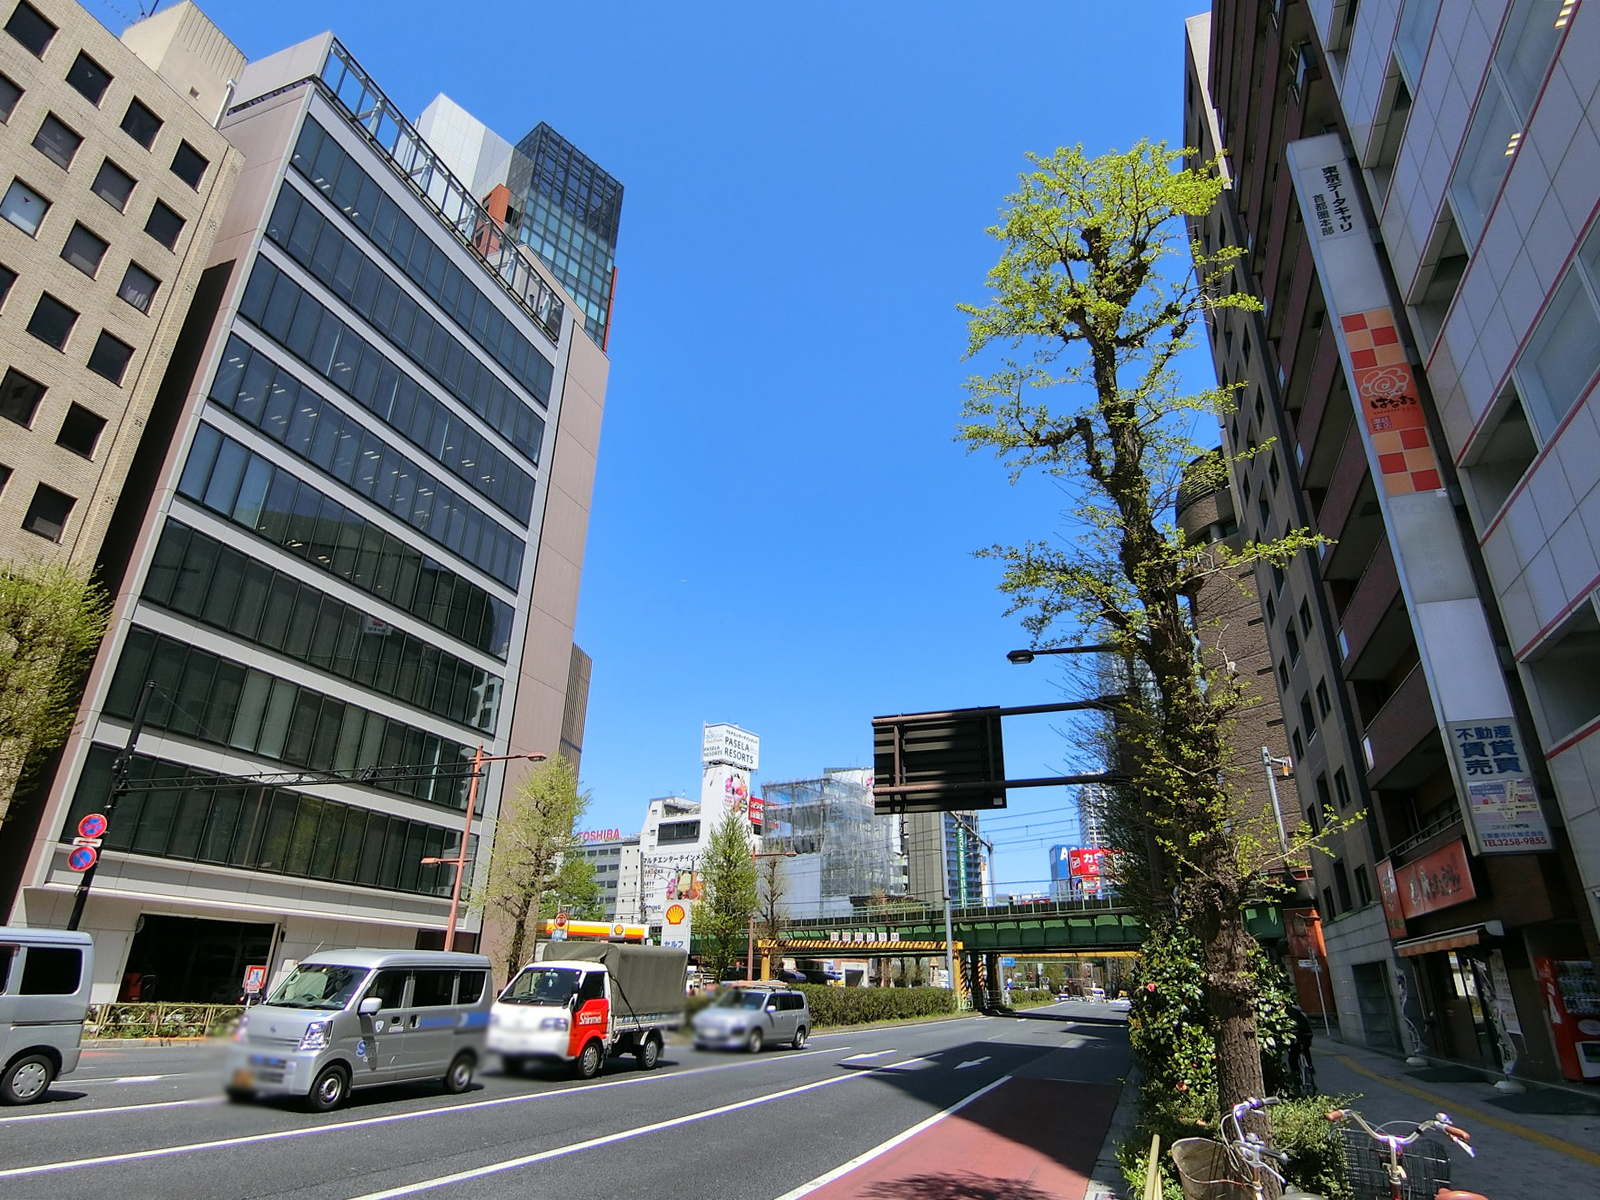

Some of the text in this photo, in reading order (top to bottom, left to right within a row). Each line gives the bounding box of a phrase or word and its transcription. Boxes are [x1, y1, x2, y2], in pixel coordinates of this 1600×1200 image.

[1321, 165, 1353, 232] 東京データキャリ
[1370, 394, 1416, 409] はなまる
[1455, 725, 1513, 741] 不動産
[724, 736, 750, 752] PASELA
[724, 747, 754, 764] RESORTS
[1465, 757, 1523, 775] 売買
[577, 828, 620, 841] TOSHIBA
[1483, 837, 1547, 847] TEL3258-9855
[664, 940, 684, 948] セルフ
